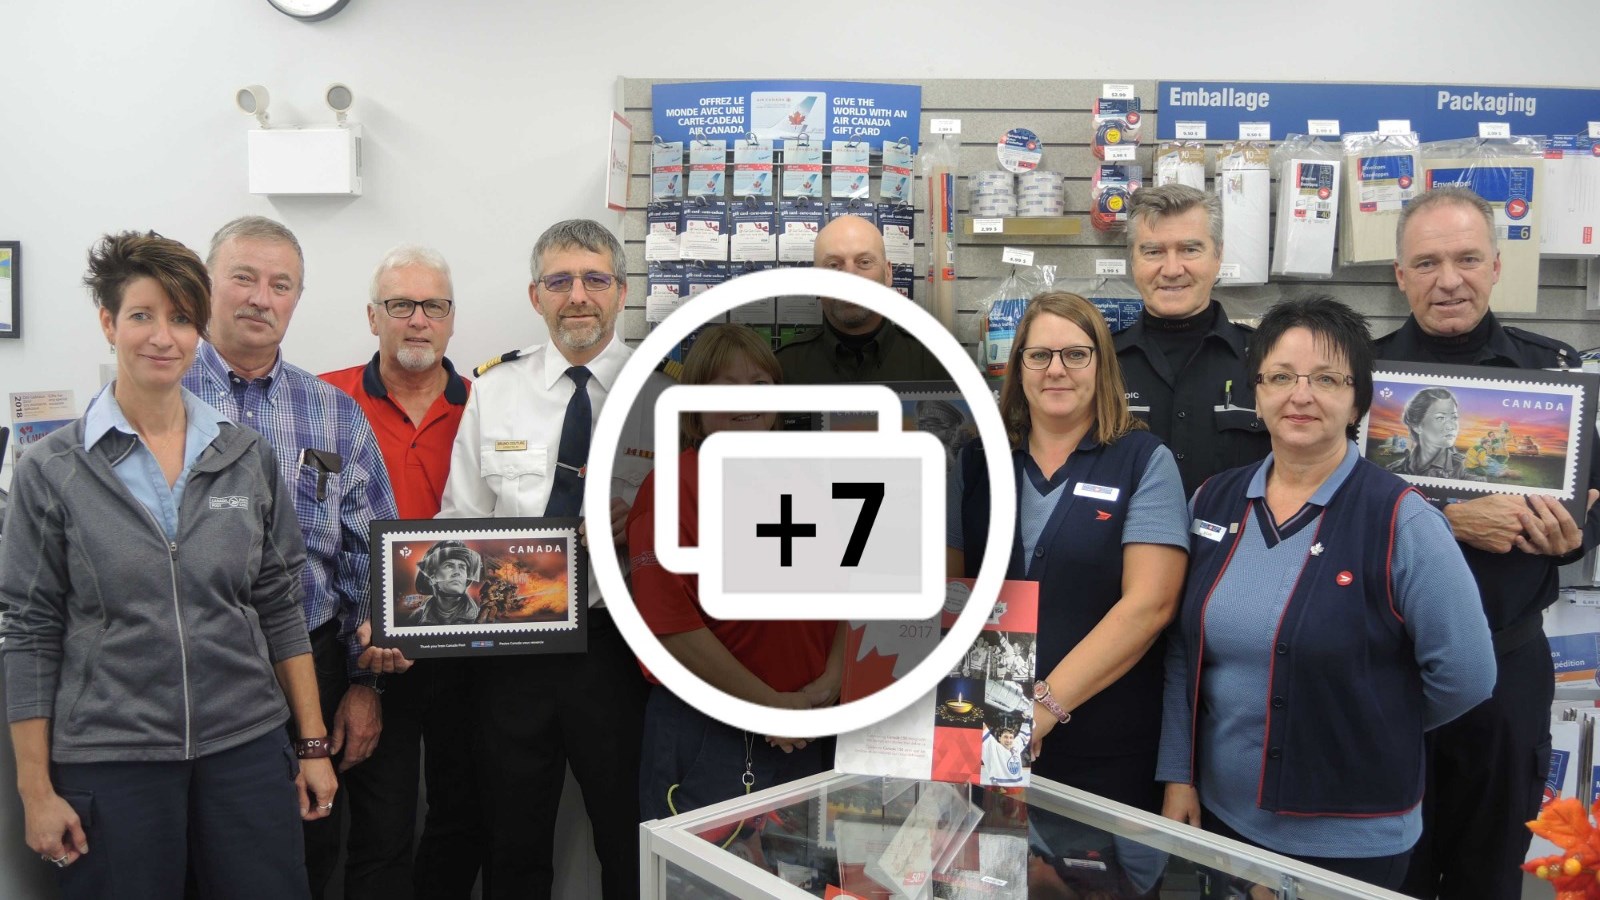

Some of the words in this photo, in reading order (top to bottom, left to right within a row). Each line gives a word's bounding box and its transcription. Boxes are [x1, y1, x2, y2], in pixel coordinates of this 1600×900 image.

[700, 97, 732, 106] OFFREZ
[734, 96, 745, 105] LE
[833, 97, 856, 106] GIVE
[858, 98, 875, 106] THE
[1170, 87, 1270, 112] Emballage
[1437, 90, 1537, 116] Packaging
[666, 108, 698, 117] MONDE
[700, 106, 724, 116] AVEC
[726, 106, 745, 115] UNE
[832, 107, 867, 116] WORLD
[869, 108, 892, 117] WITH
[894, 110, 908, 118] AN
[678, 116, 745, 126] CARTE-CADEAU
[832, 116, 850, 125] AIR
[852, 117, 892, 127] CANADA
[688, 127, 703, 135] AIR
[705, 126, 745, 135] CANADA
[832, 126, 853, 135] GIFT
[854, 127, 880, 136] CARD
[1180, 150, 1190, 159] 10
[1246, 150, 1254, 159] 10
[1432, 180, 1472, 188] Envelopes
[1521, 227, 1529, 239] 6
[15, 396, 23, 418] 2018
[1502, 398, 1564, 411] CANADA
[509, 544, 561, 554] CANADA
[899, 624, 933, 638] 2017
[1554, 660, 1585, 669] pédition
